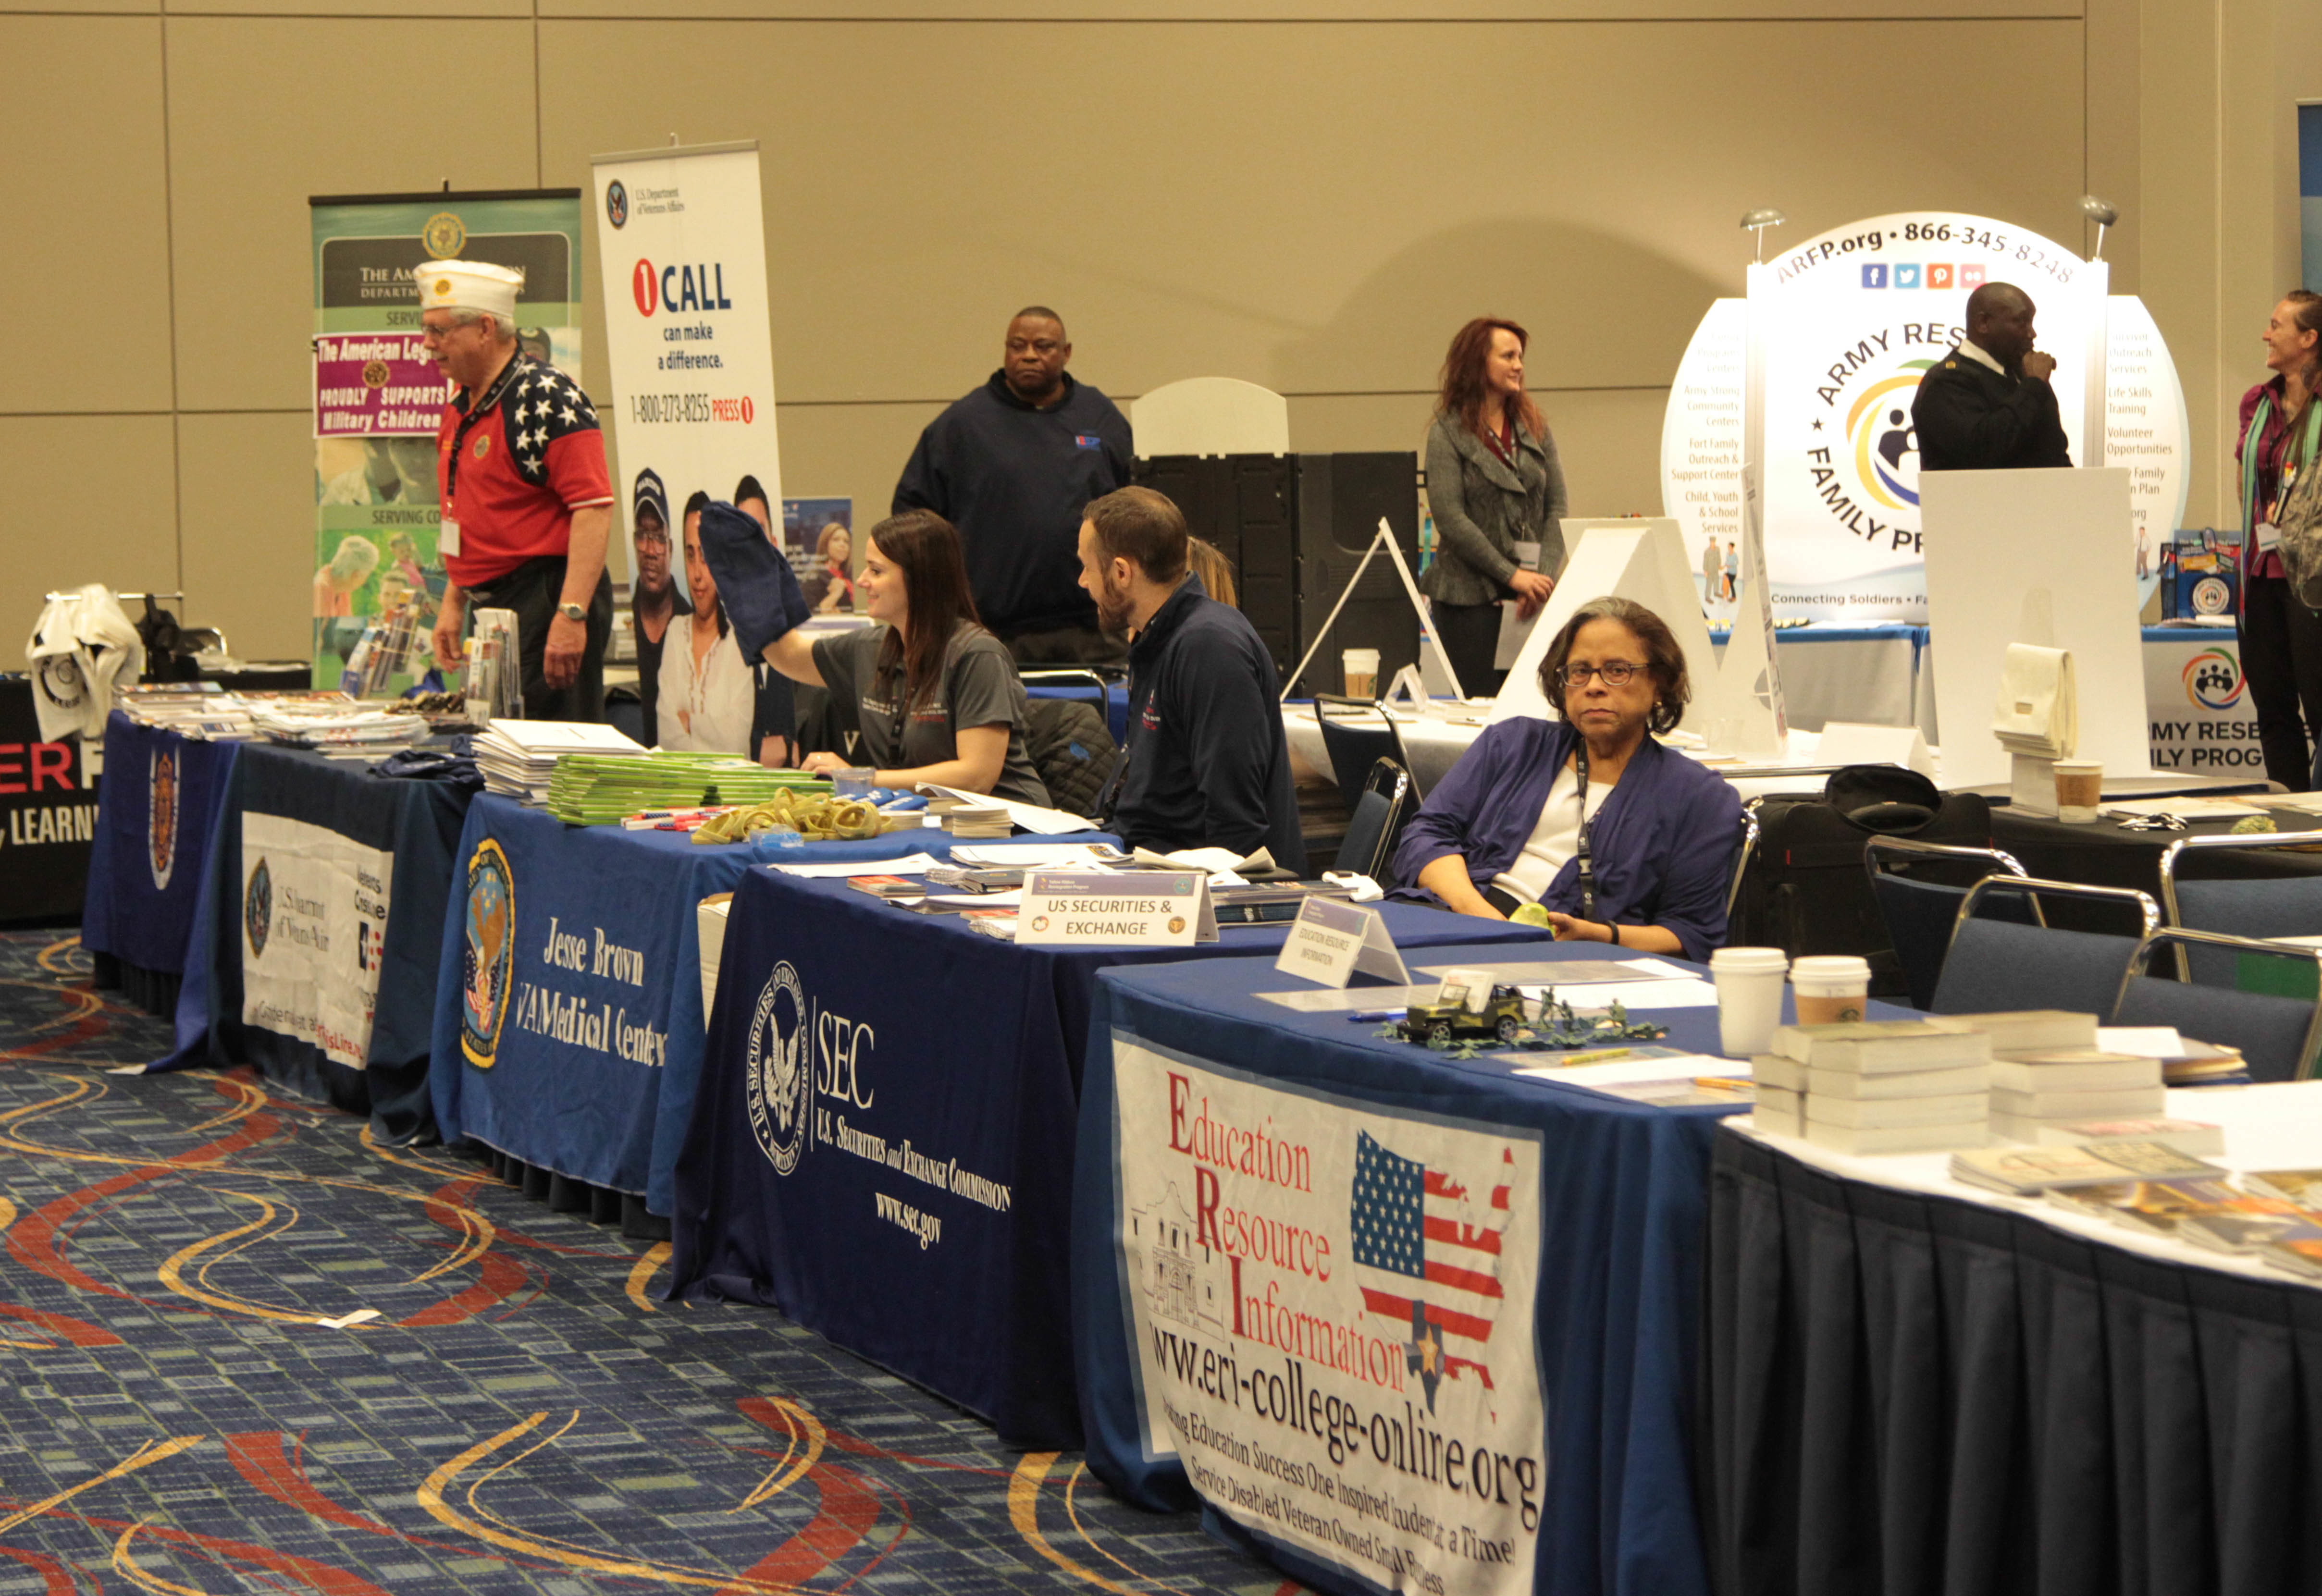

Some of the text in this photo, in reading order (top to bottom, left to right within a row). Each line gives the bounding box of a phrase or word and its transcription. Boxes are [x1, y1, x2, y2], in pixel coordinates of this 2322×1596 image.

[1777, 223, 2074, 284] ARFP.org 866-345-8248
[360, 267, 386, 282] THE
[361, 287, 419, 298] DEPARTM
[661, 263, 732, 313] CALL
[664, 320, 713, 341] can make
[318, 337, 432, 367] The American Leg
[658, 350, 723, 370] a difference.
[1816, 329, 1890, 407] ARMY
[320, 386, 446, 407] PROUDLY SUPPORTS
[1684, 385, 1707, 397] Army
[2108, 387, 2152, 398] Life Skills
[630, 393, 710, 424] 1-800-273-8255
[712, 398, 740, 422] PRESS
[1687, 400, 1740, 412] Community
[2108, 403, 2147, 417] Training
[322, 409, 442, 433] Military Children
[1706, 416, 1740, 427] Centers
[2107, 427, 2153, 438] Volunteer
[1689, 438, 1740, 452] Fort Family
[2107, 443, 2173, 455] Opportunities
[1689, 454, 1739, 465] Outreach &
[1671, 469, 1739, 482] Support Center
[2134, 467, 2165, 480] Family
[1685, 491, 1739, 503] Child, Youth
[1807, 446, 1887, 542] FAMILY
[2139, 484, 2160, 495] Plan
[372, 510, 424, 525] SERVING
[1699, 507, 1739, 518] & School
[2131, 509, 2147, 521] org
[1701, 523, 1739, 534] Services
[1771, 594, 1845, 605] Connecting
[1849, 594, 1902, 604] Soldiers
[2151, 722, 2260, 740] MY RESE
[2150, 748, 2262, 767] ILY PROG
[10, 804, 99, 846] LEARN
[1048, 900, 1173, 913] US SECURITIES &
[1065, 921, 1148, 935] EXCHANGE
[544, 917, 644, 987] Jesse Brown
[615, 1007, 668, 1067] Center
[749, 986, 775, 1091] SECURITIES
[817, 1010, 874, 1109] SEC
[750, 1091, 765, 1129] U.S.
[1167, 1070, 1313, 1193] Education
[817, 1107, 833, 1145] U.S.
[837, 1115, 886, 1164] SECURITIES
[886, 1144, 903, 1171] and
[903, 1139, 947, 1190] EXCHANGE
[948, 1157, 1011, 1212] COMMISSION
[875, 1191, 941, 1251] www.sec.gov
[1194, 1165, 1332, 1283] Resource
[1227, 1253, 1406, 1394] Information
[1189, 1412, 1250, 1466] Education
[1253, 1441, 1305, 1486] Success
[1307, 1462, 1334, 1499] One
[1336, 1473, 1389, 1525] Inspired
[1449, 1530, 1457, 1554] a
[1461, 1525, 1516, 1567] Time!
[1191, 1455, 1227, 1498] Service
[1227, 1475, 1281, 1521] Disabled
[1281, 1497, 1333, 1542] Veteran
[1332, 1518, 1373, 1560] Owned
